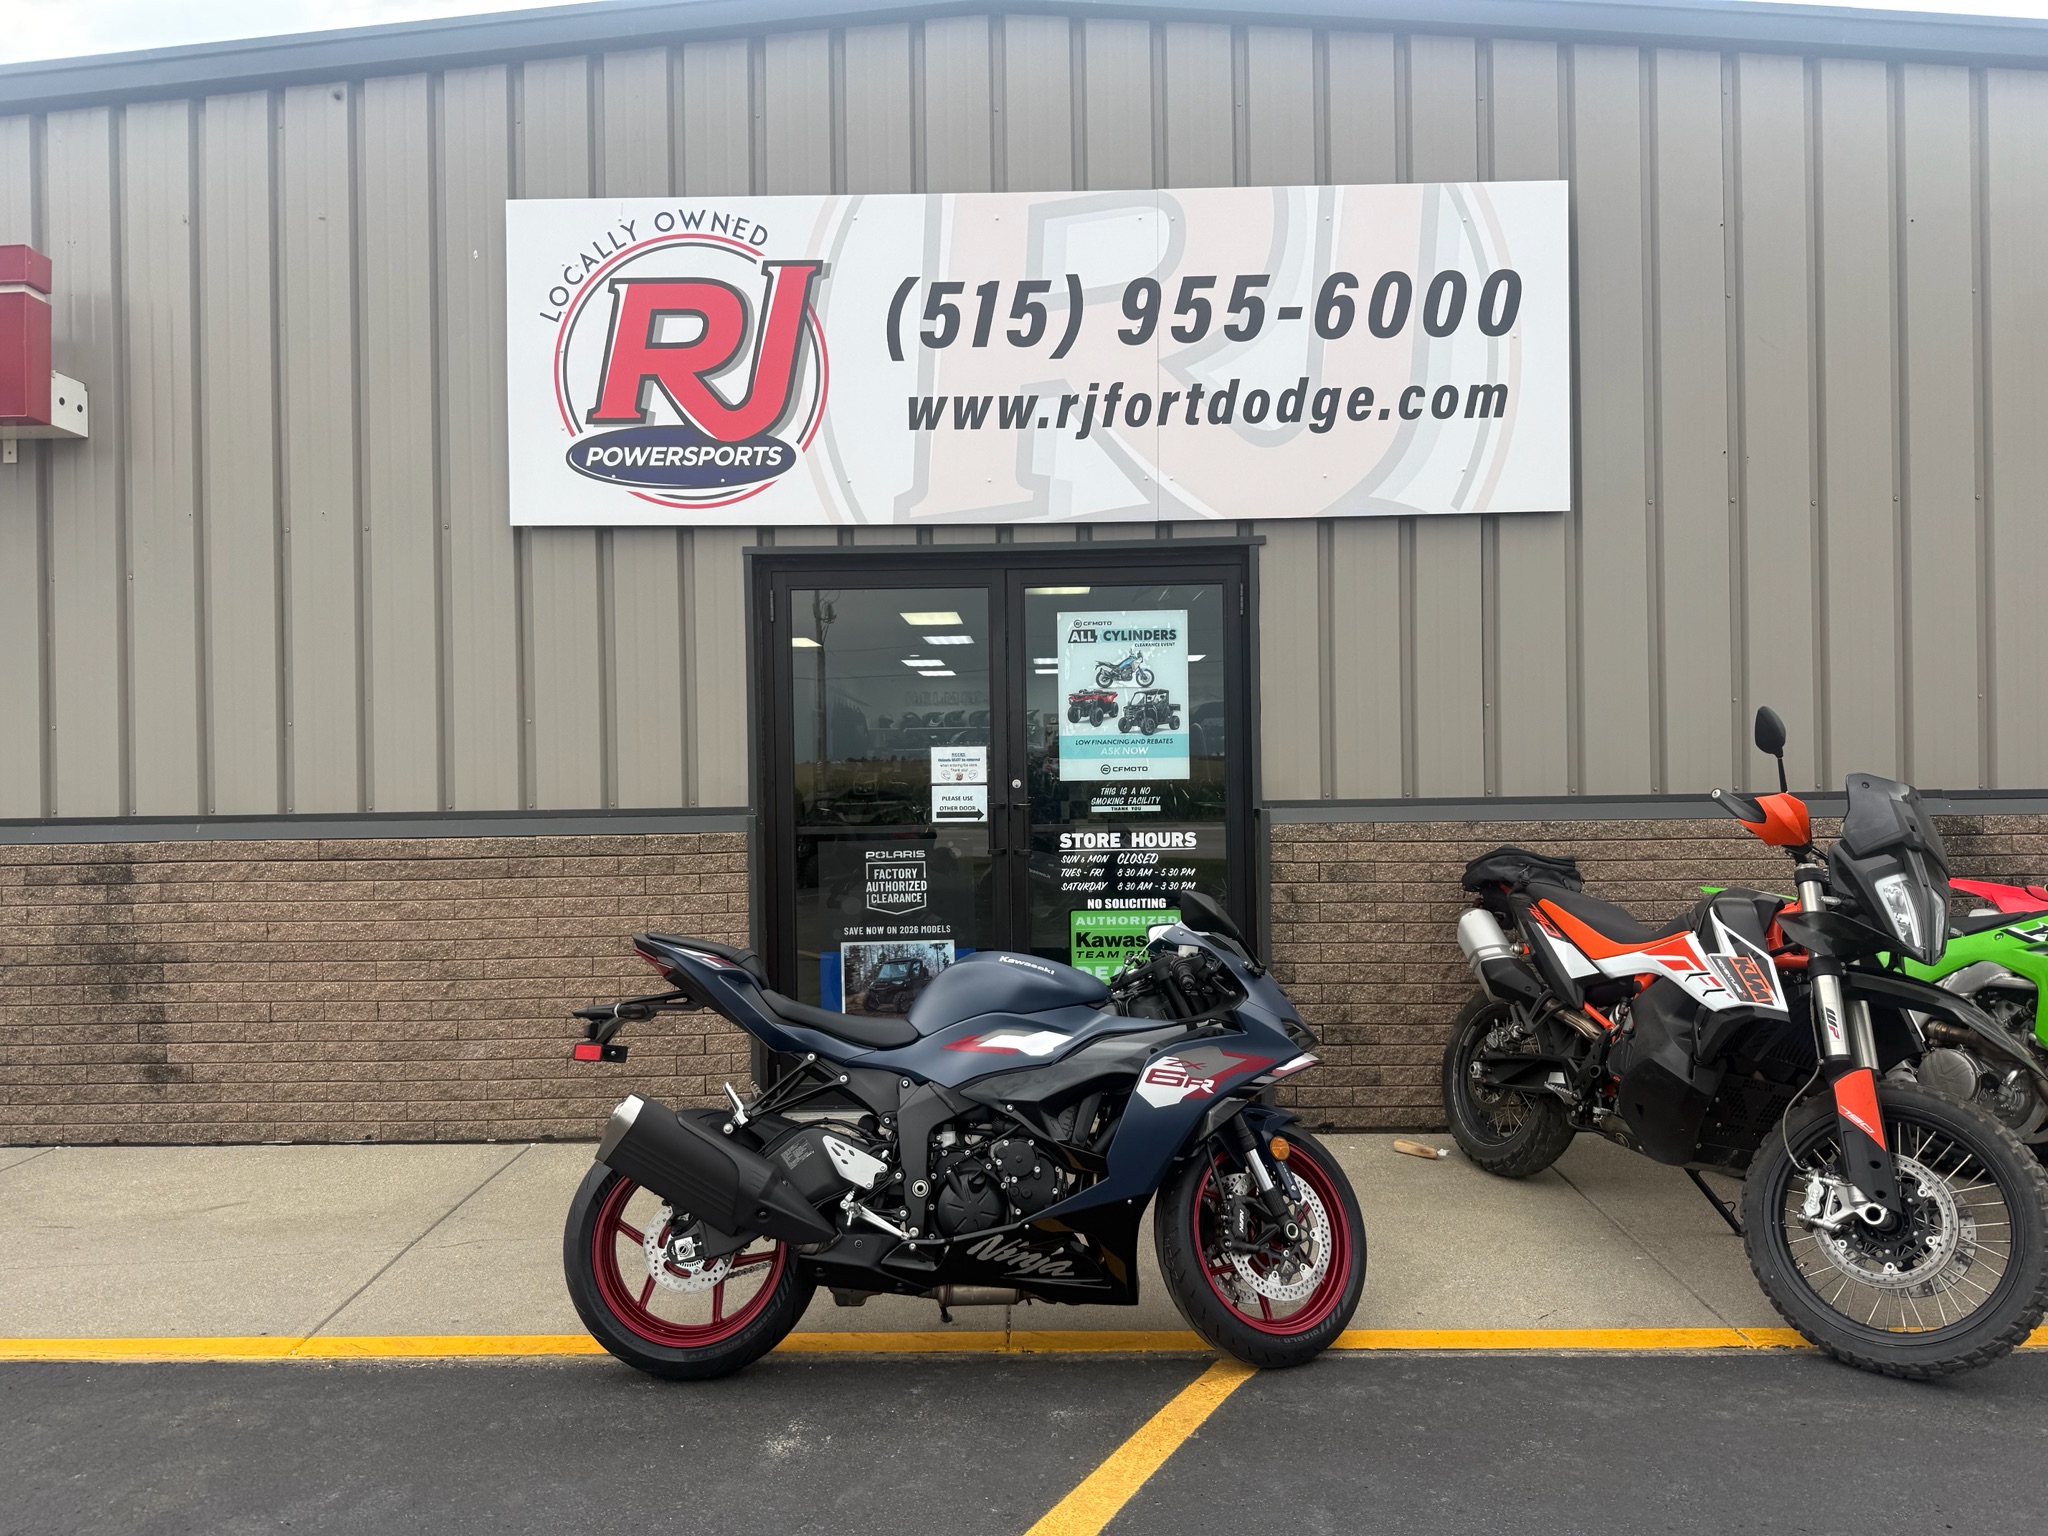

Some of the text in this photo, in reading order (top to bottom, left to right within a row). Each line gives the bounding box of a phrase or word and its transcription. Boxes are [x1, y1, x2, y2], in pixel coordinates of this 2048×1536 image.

[540, 209, 768, 322] LOCALLY OWNED
[886, 268, 1523, 362] (515) 955-6000
[585, 259, 826, 442] RJ
[906, 376, 1509, 440] www.rjfortdodge.com
[585, 446, 783, 467] POWERSPORTS
[1069, 629, 1177, 643] ALL CYLINDERS
[1100, 746, 1149, 755] ASK NOW
[1100, 787, 1116, 795] THIS
[1140, 786, 1150, 794] NO
[1091, 796, 1161, 805] SMOKING FACILITY
[1059, 832, 1197, 848] STORE HOURS
[866, 850, 926, 859] POLARIS
[1061, 854, 1080, 864] SUN
[1086, 854, 1110, 864] MON
[1117, 852, 1158, 864] CLOSED
[874, 868, 918, 880] FACTORY
[1061, 868, 1082, 877] TUES
[1089, 868, 1104, 877] FRI
[1136, 868, 1153, 876] AM
[1180, 868, 1196, 876] PM
[866, 880, 928, 892] AUTHORIZED
[1061, 882, 1108, 891] SATURDAY
[1136, 882, 1153, 890] AM
[1180, 882, 1196, 890] PM
[871, 892, 922, 904] CLEARANCE
[1087, 898, 1166, 910] NO SOLICITING
[1076, 916, 1178, 926] AUTHORIZED
[844, 924, 951, 936] SAVE NOW ON 2026 MODELS
[1076, 932, 1148, 948] Kawas
[998, 955, 1055, 975] Kawasaki
[1716, 958, 1742, 994] ADVENTURE
[1731, 957, 1773, 1002] KTM
[1825, 1006, 1840, 1040] WP
[1165, 1057, 1207, 1070] ZX
[1145, 1068, 1215, 1094] 6R
[966, 1234, 1075, 1276] Ninja
[1283, 1328, 1320, 1344] DIABLO
